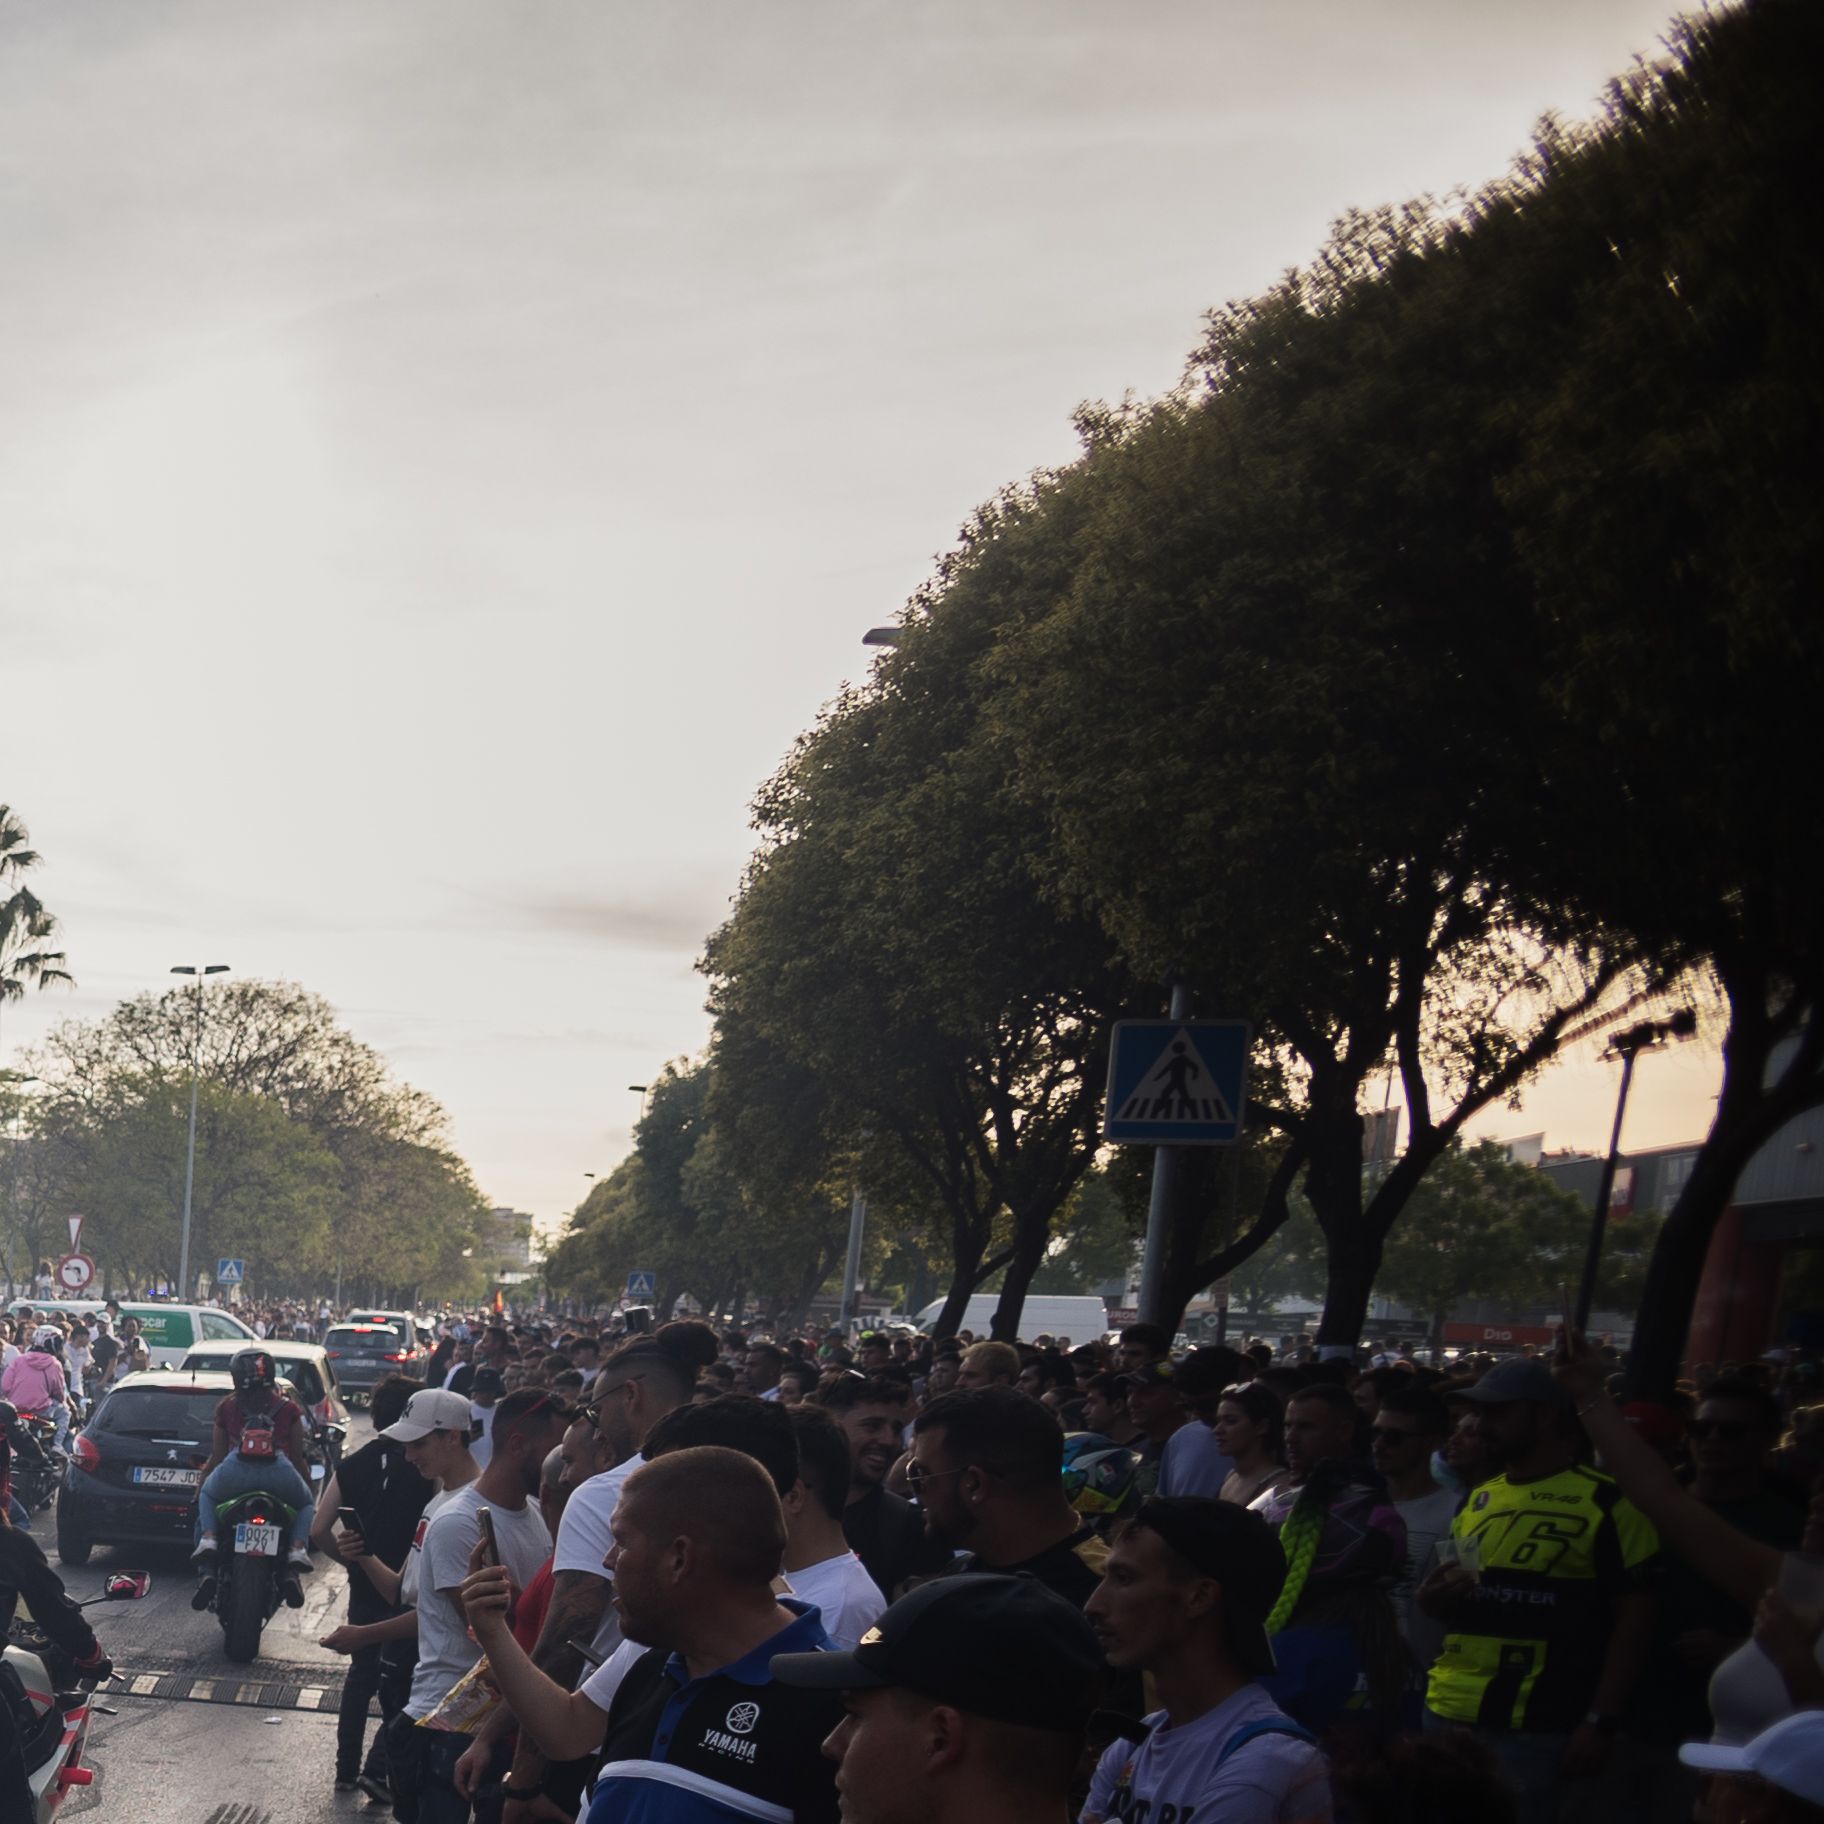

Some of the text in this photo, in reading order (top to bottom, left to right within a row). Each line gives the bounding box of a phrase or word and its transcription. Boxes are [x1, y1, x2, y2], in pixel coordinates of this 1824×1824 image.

[145, 1470, 176, 1482] 7547
[1460, 1584, 1556, 1606] ONSTER
[703, 1728, 758, 1760] YAMAHA
